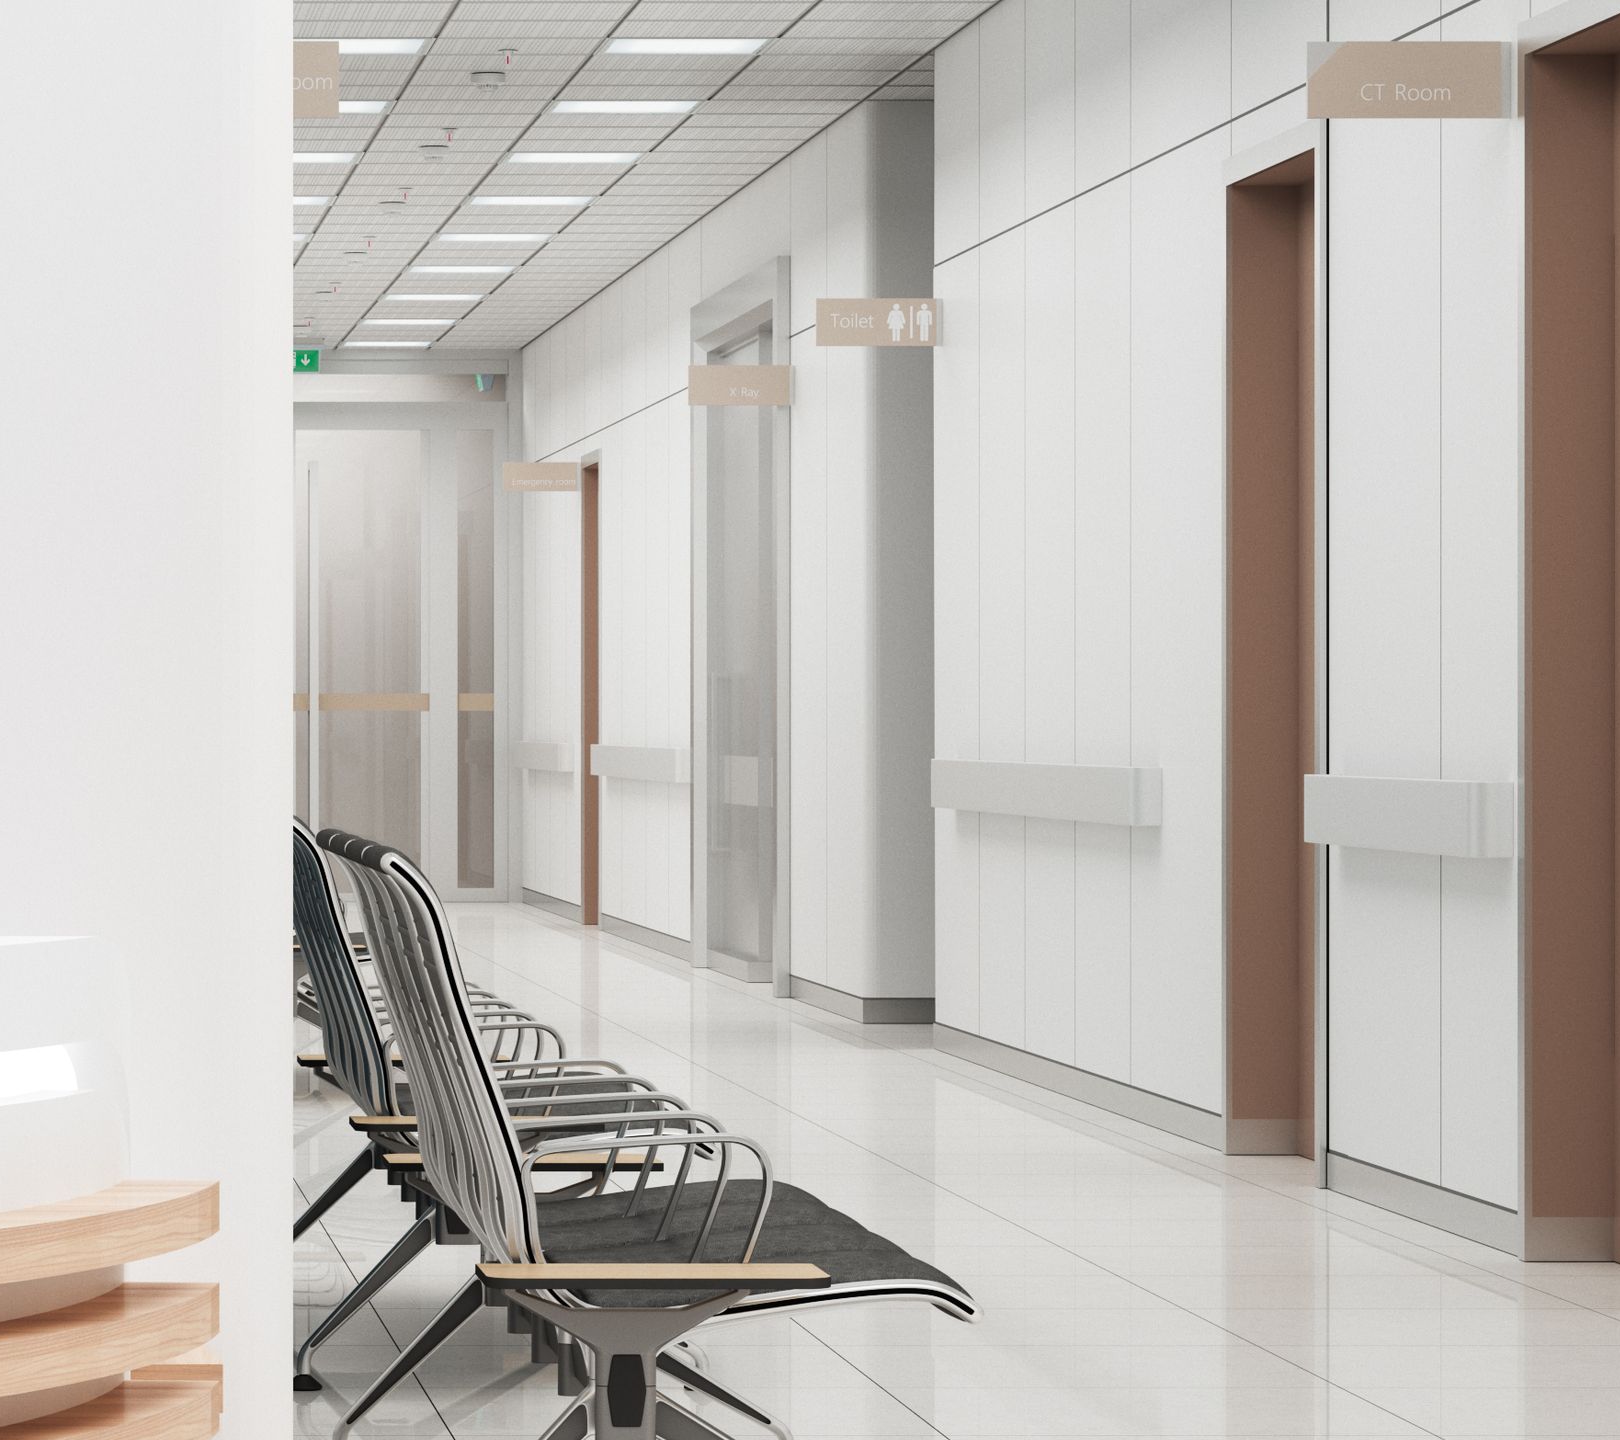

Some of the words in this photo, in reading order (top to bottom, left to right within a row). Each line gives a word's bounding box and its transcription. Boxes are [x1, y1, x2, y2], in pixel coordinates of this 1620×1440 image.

[1360, 83, 1386, 102] CT
[1395, 83, 1452, 102] Room
[830, 312, 874, 330] Toilet
